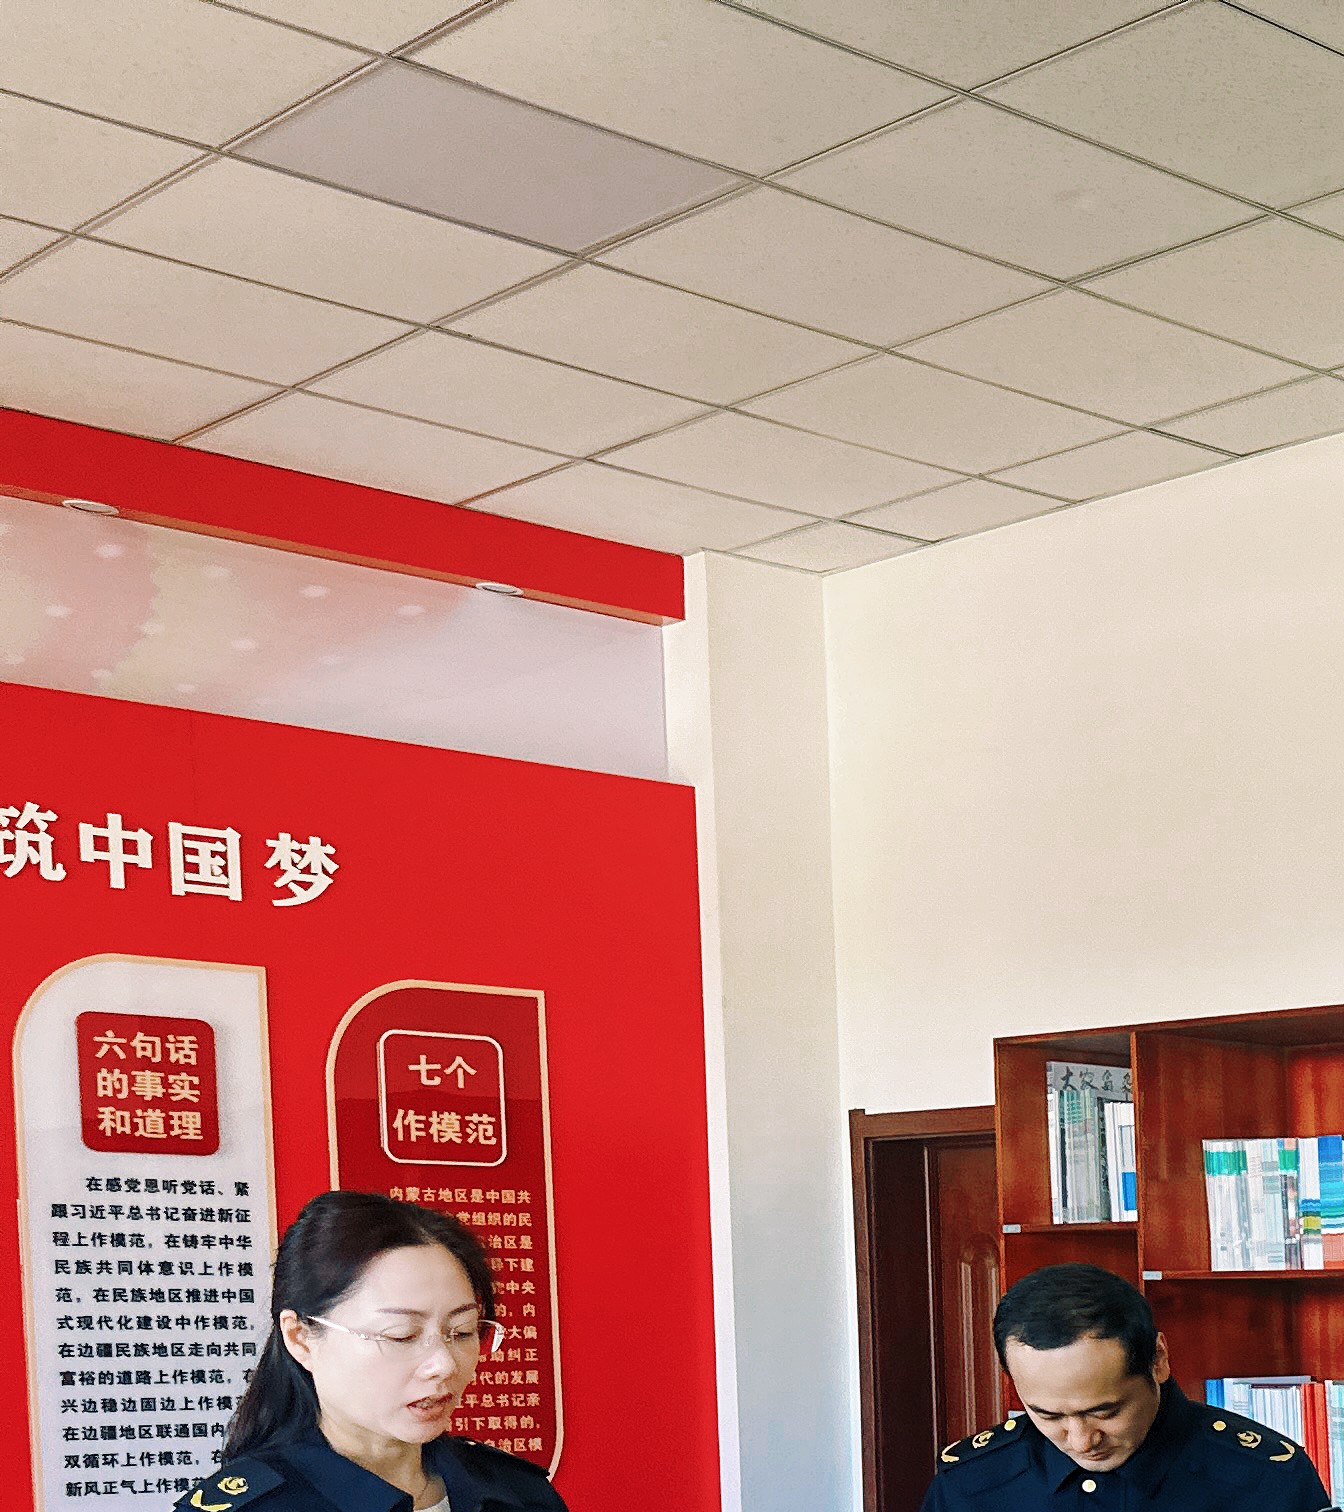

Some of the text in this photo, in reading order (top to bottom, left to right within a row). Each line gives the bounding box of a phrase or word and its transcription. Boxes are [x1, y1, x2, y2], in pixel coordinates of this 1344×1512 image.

[0, 801, 339, 907] 筑中国梦
[93, 1030, 199, 1066] 六句话
[96, 1068, 201, 1104] 的事实
[408, 1054, 477, 1090] 七个
[97, 1106, 204, 1142] 和道理
[392, 1108, 497, 1147] 作模范
[54, 1259, 254, 1277] 民族共同体意识上作模
[58, 1341, 257, 1359] 在边疆民族地区走向共同
